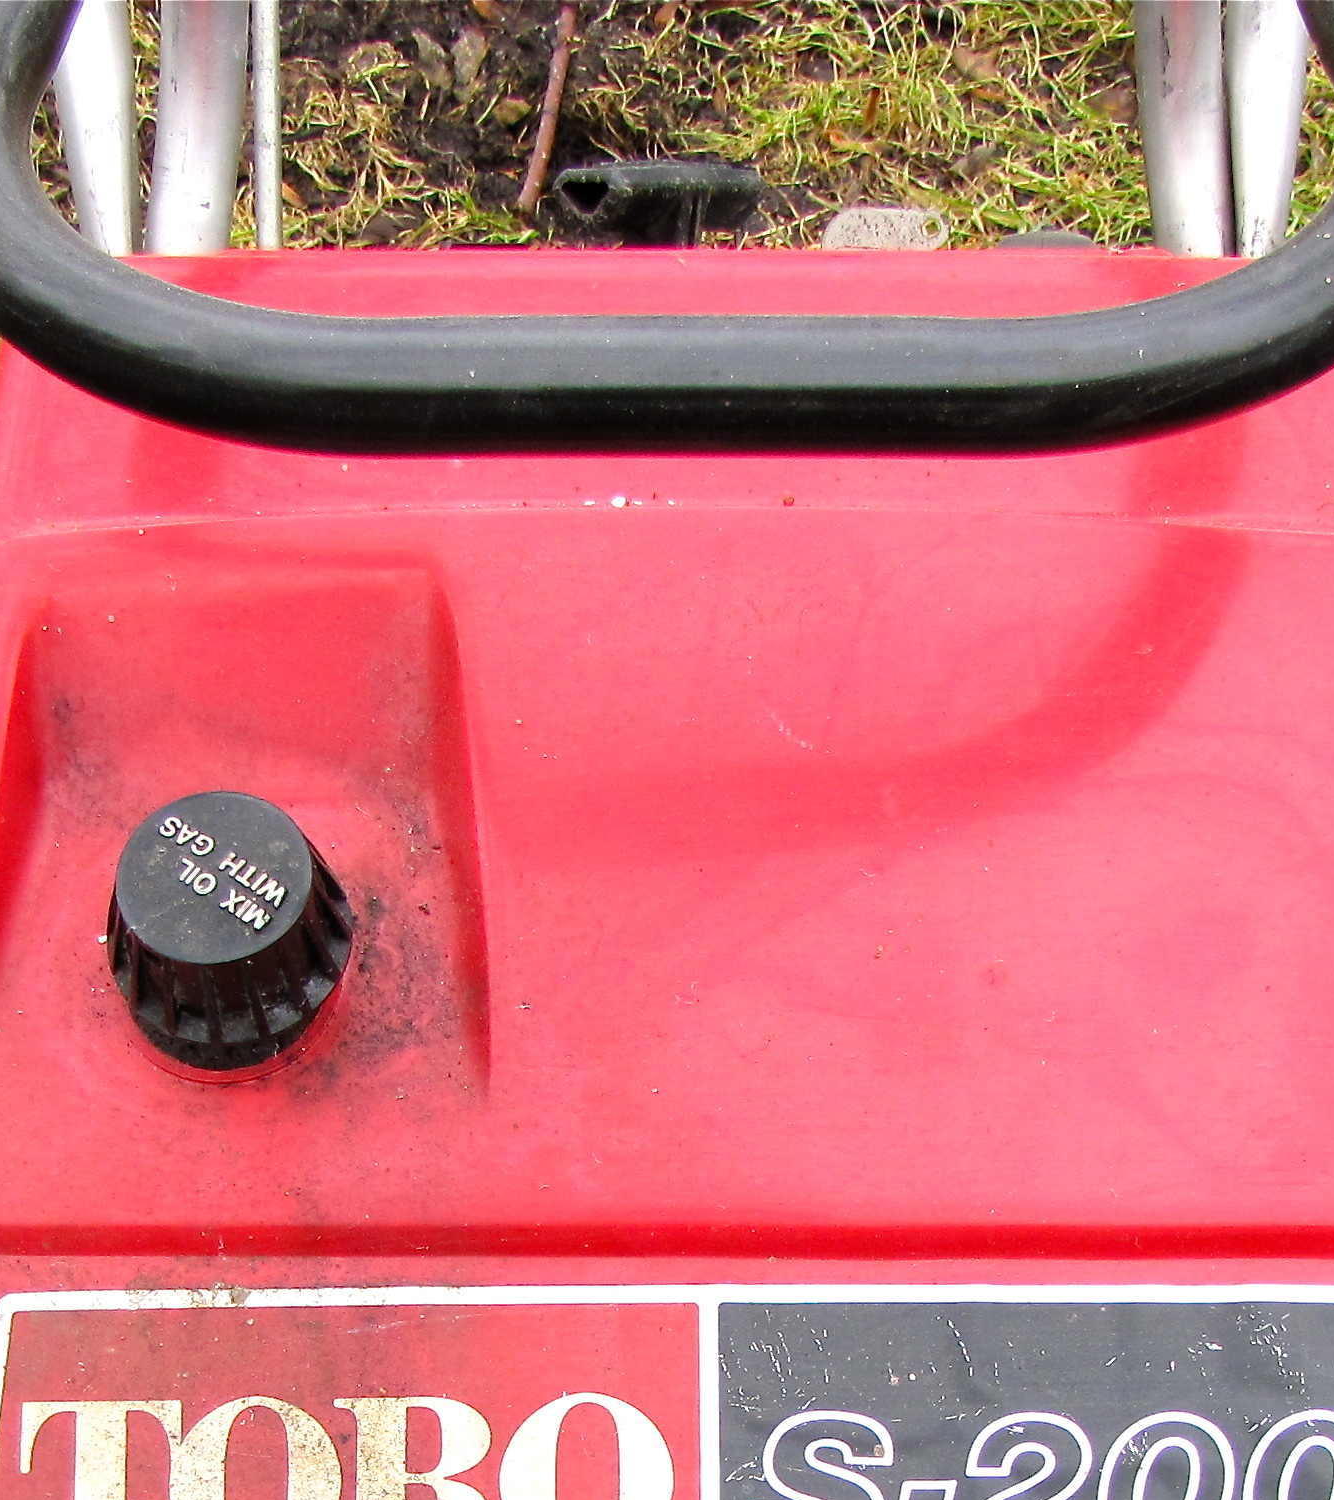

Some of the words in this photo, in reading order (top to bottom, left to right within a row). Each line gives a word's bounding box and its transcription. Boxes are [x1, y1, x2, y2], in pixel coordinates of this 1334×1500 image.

[157, 816, 215, 856] GAS
[179, 858, 217, 896] OIL
[219, 852, 288, 908] WITH
[219, 888, 271, 930] MIX
